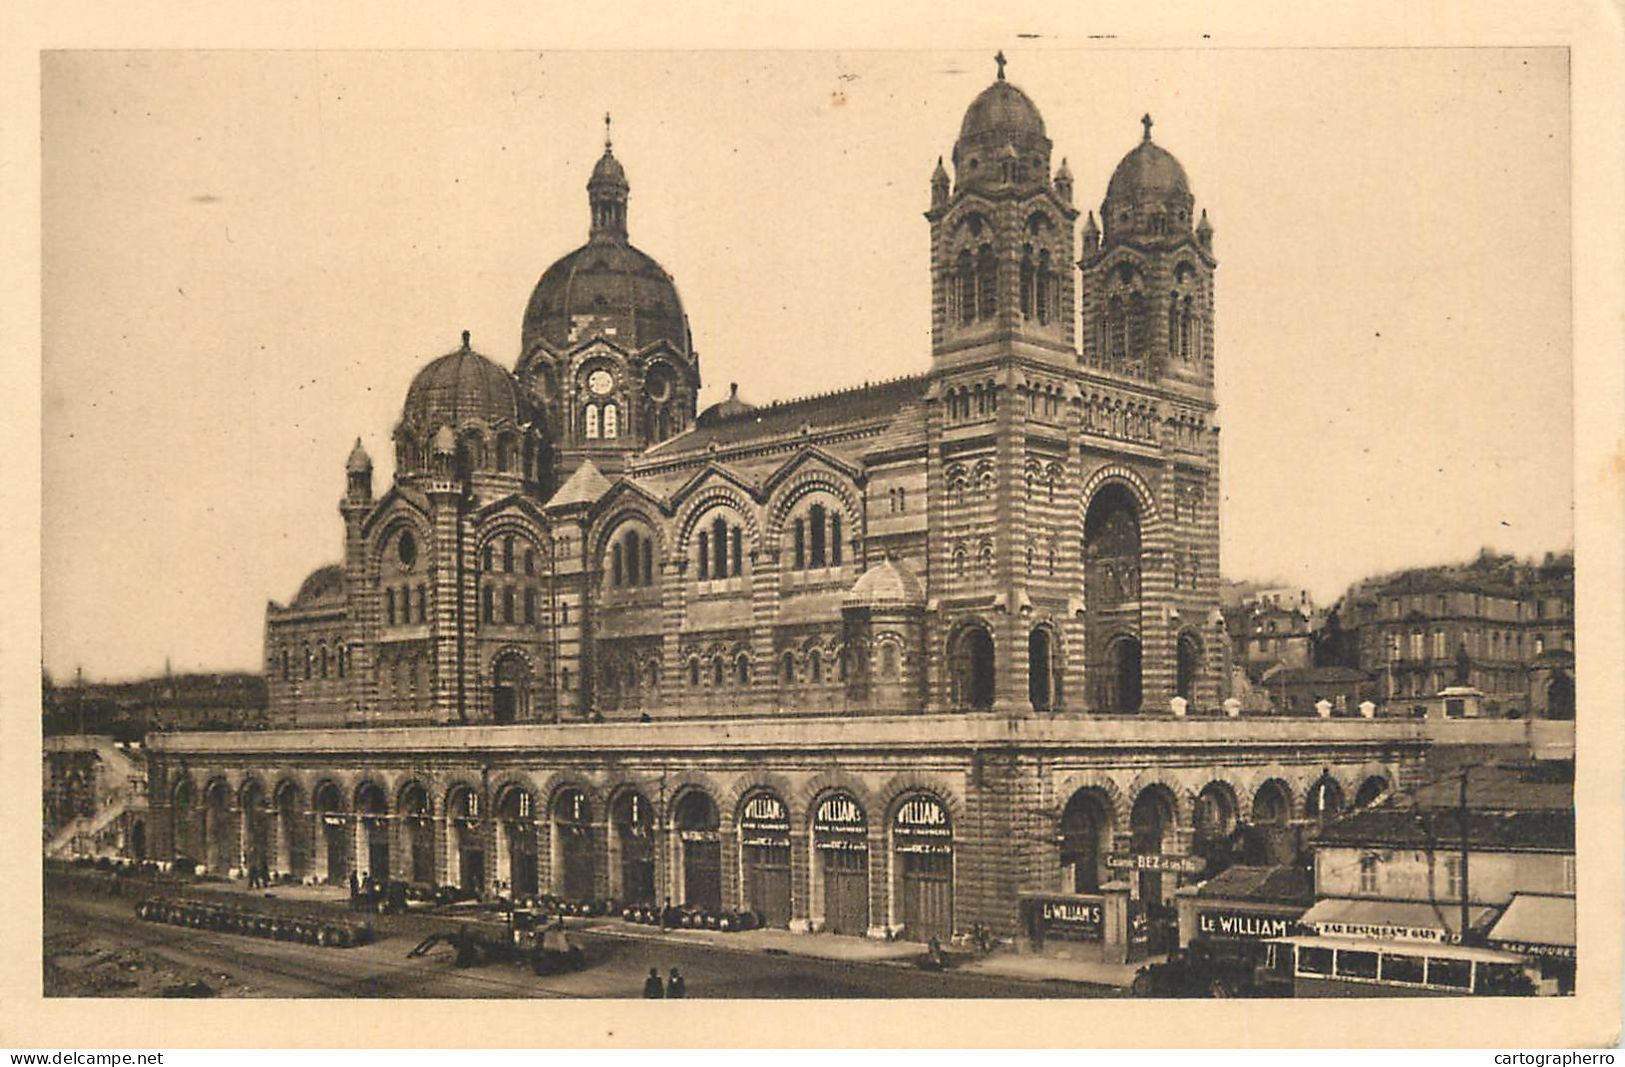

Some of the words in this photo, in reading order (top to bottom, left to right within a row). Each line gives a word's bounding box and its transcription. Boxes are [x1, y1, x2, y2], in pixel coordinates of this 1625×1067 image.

[1137, 854, 1160, 869] BEZ
[1323, 924, 1344, 934] BAR
[1346, 925, 1408, 937] RESTAURANT
